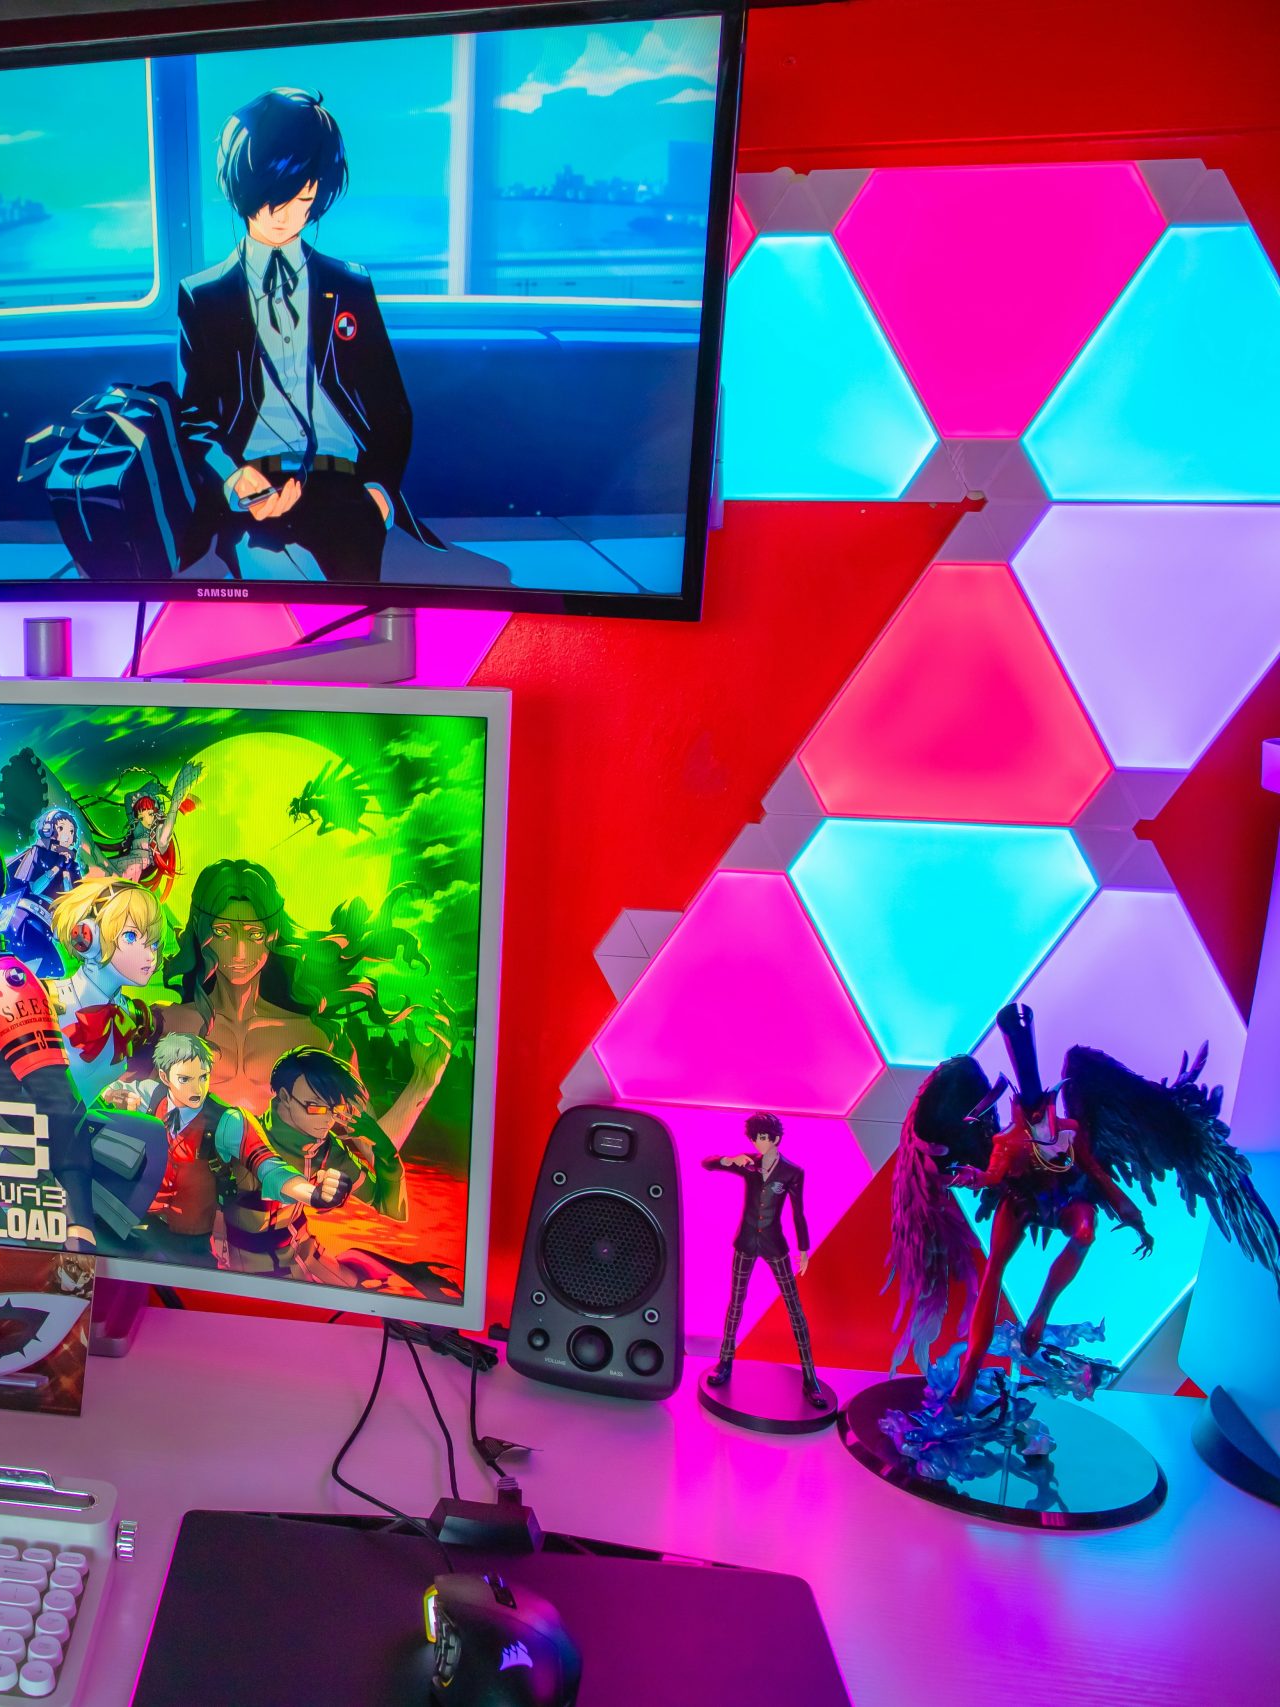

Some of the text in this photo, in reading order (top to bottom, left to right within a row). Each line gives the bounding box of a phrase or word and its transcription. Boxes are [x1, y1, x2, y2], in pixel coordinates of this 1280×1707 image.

[197, 588, 249, 598] SAMSUNG
[1, 998, 56, 1023] S.E.E.S.
[36, 1030, 47, 1050] 3
[544, 1357, 567, 1366] VOLUME
